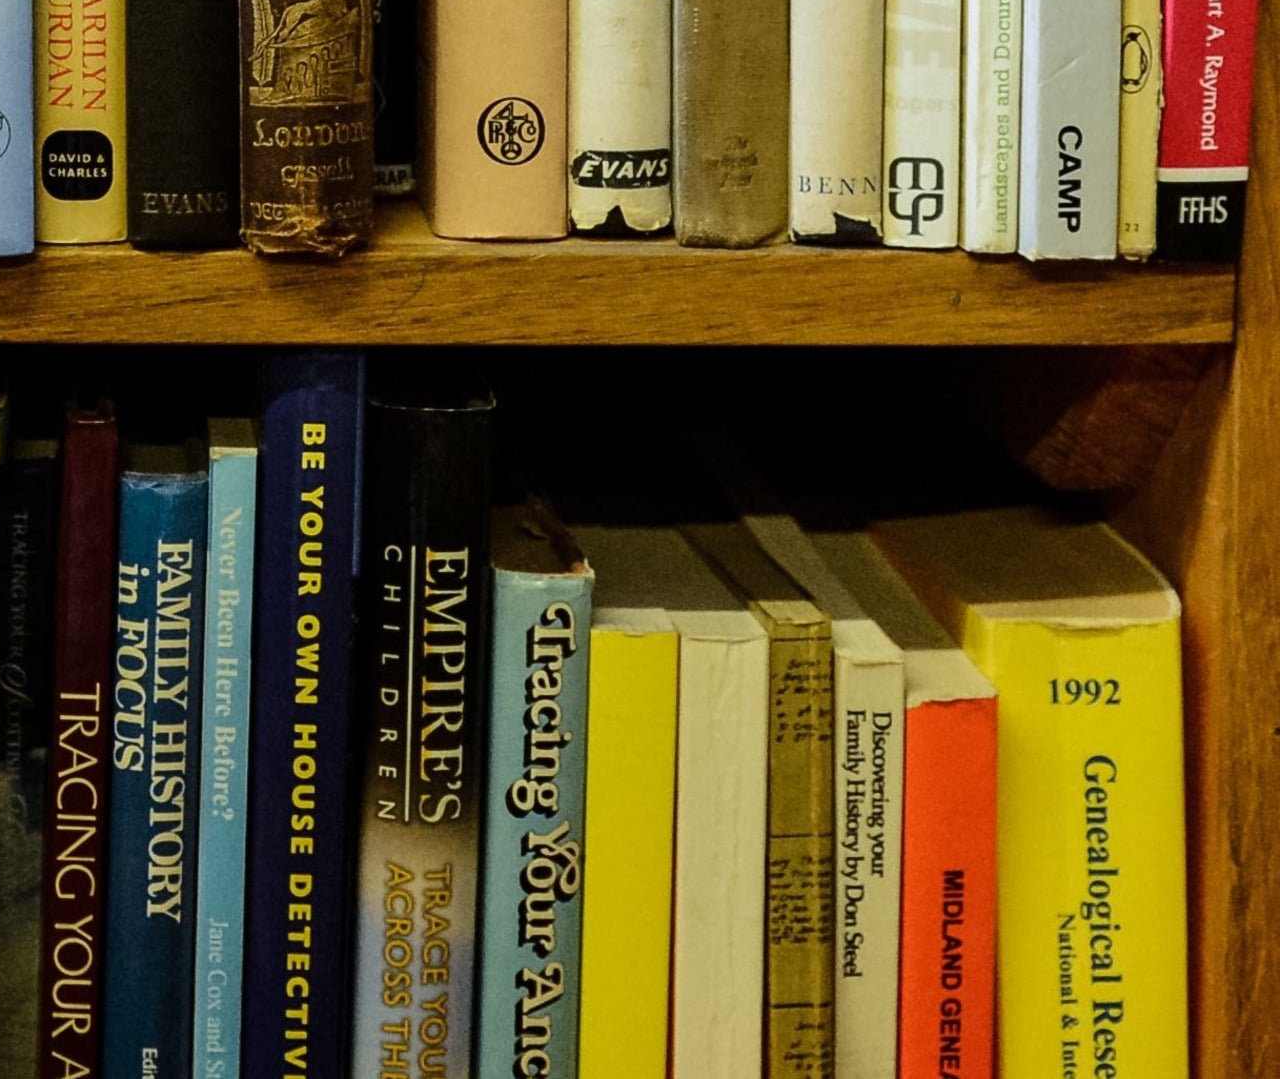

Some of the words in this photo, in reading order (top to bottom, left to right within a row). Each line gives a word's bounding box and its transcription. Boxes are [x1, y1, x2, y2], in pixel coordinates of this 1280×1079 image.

[1204, 24, 1225, 48] A.
[998, 69, 1012, 107] and
[1198, 55, 1224, 151] Raymond
[48, 152, 92, 164] DAVID
[95, 152, 106, 164] &
[48, 167, 108, 179] CHARLES
[577, 155, 670, 180] EVANS
[798, 174, 879, 196] BENN
[1057, 125, 1084, 234] CAMP
[142, 193, 229, 215] EVANS
[1179, 195, 1229, 225] FFHS
[301, 422, 326, 471] BE
[218, 507, 243, 580] Never
[297, 485, 325, 597] YOUR
[152, 538, 194, 712] FAMILY
[217, 586, 241, 650] Been
[294, 614, 322, 705] OWN
[112, 619, 151, 773] FOCUS
[214, 656, 239, 721] Here
[376, 543, 404, 820] CHILDREN
[420, 546, 470, 824] EMPIRE'S
[506, 600, 580, 816] Tracing
[1048, 677, 1122, 707] 1992
[210, 726, 238, 821] Before?
[842, 709, 867, 775] Family
[868, 710, 893, 830] Discovering
[54, 681, 101, 901] TRACING
[146, 721, 190, 924] HISTORY
[290, 722, 318, 855] HOUSE
[842, 778, 867, 853] History
[520, 824, 580, 956] Your
[841, 856, 864, 882] by
[870, 832, 886, 878] your
[1081, 754, 1123, 984] Genealogical
[382, 864, 414, 1008] ACROSS
[421, 866, 452, 985] TRACE
[843, 883, 865, 925] Don
[940, 869, 965, 991] MIDLAND
[51, 912, 94, 1039] YOUR
[842, 928, 864, 980] Steel
[1057, 914, 1079, 1007] National
[205, 1014, 225, 1049] and
